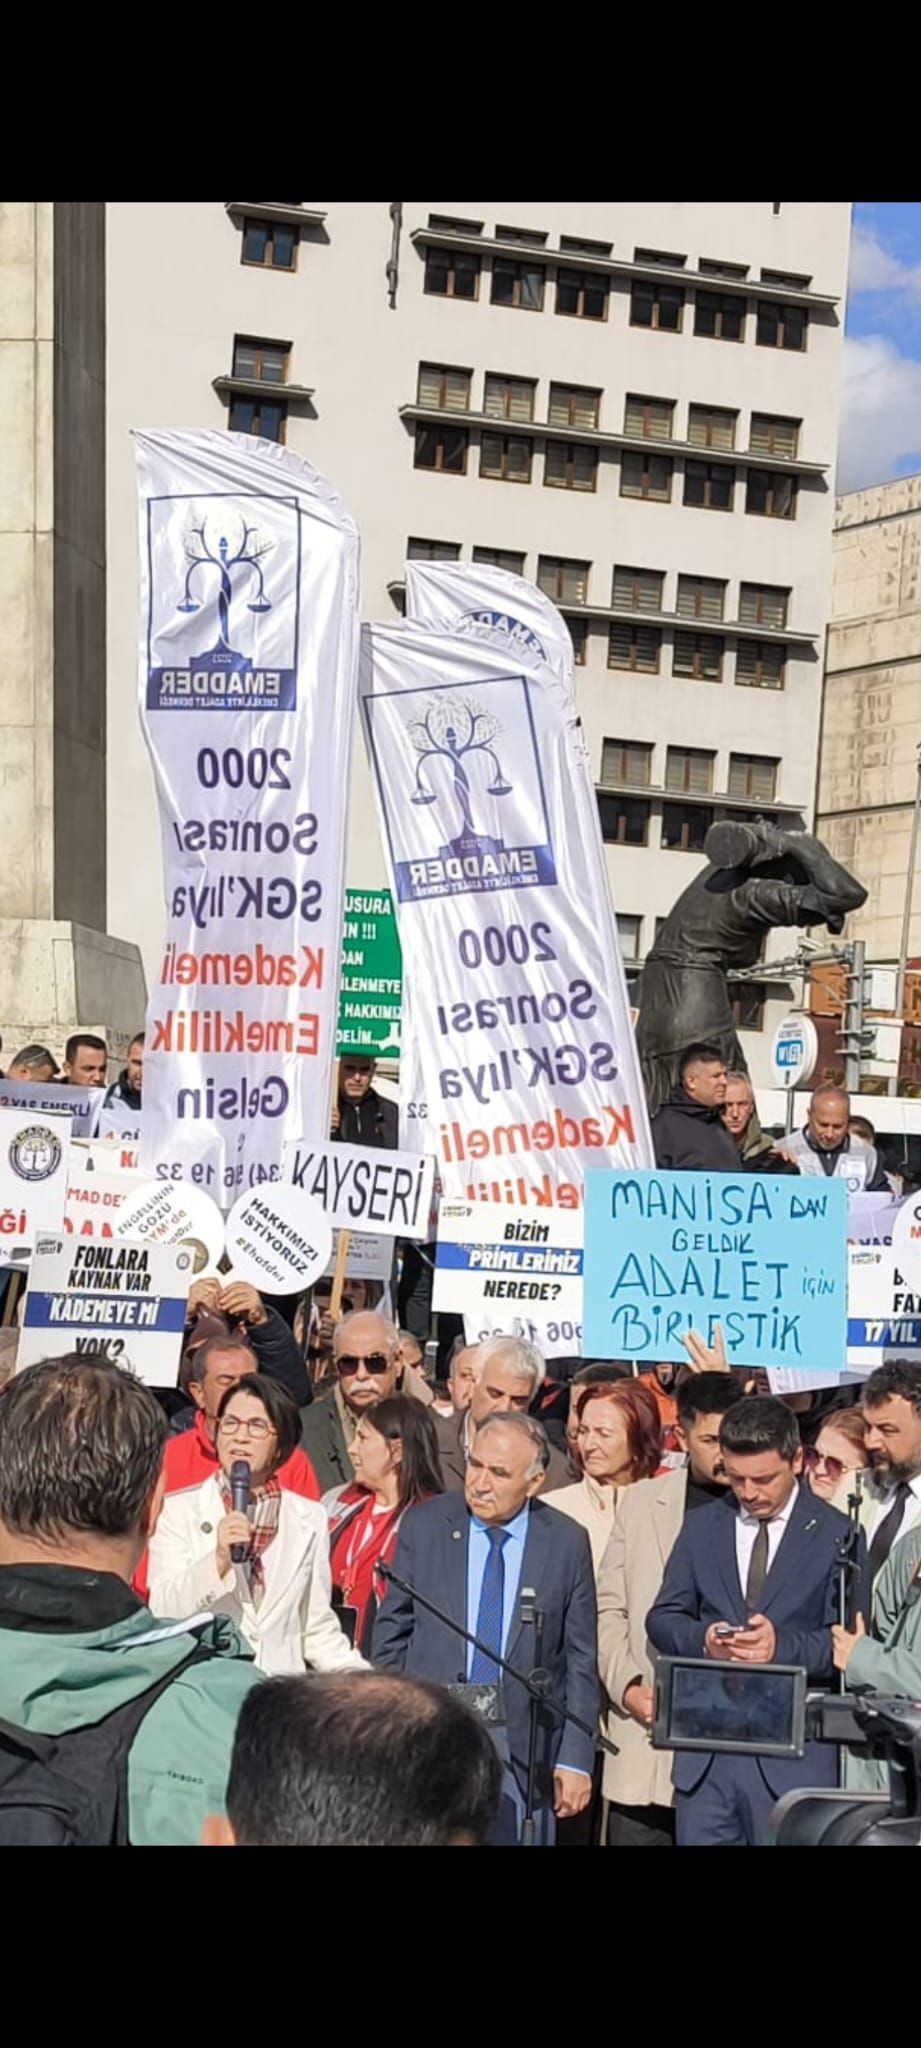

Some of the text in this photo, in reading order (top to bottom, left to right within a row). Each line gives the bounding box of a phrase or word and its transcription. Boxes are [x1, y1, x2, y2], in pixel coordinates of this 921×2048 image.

[103, 1193, 127, 1208] DE
[292, 1150, 425, 1226] KAYSERİ
[240, 1209, 309, 1275] İSTİYORUZ
[250, 1198, 319, 1261] HAKKIMIZI
[504, 1219, 549, 1242] BİZİM
[672, 1228, 754, 1253] GELDİK
[74, 1245, 149, 1272] FONLARA
[468, 1248, 579, 1273] PRİMLERİMİZ
[68, 1269, 151, 1292] KAYNAK VAR
[610, 1253, 788, 1301] ADALET
[483, 1280, 562, 1301] NEREDE?
[50, 1295, 160, 1326] KADEMEYE Mİ
[865, 1319, 917, 1344] 17 YIL
